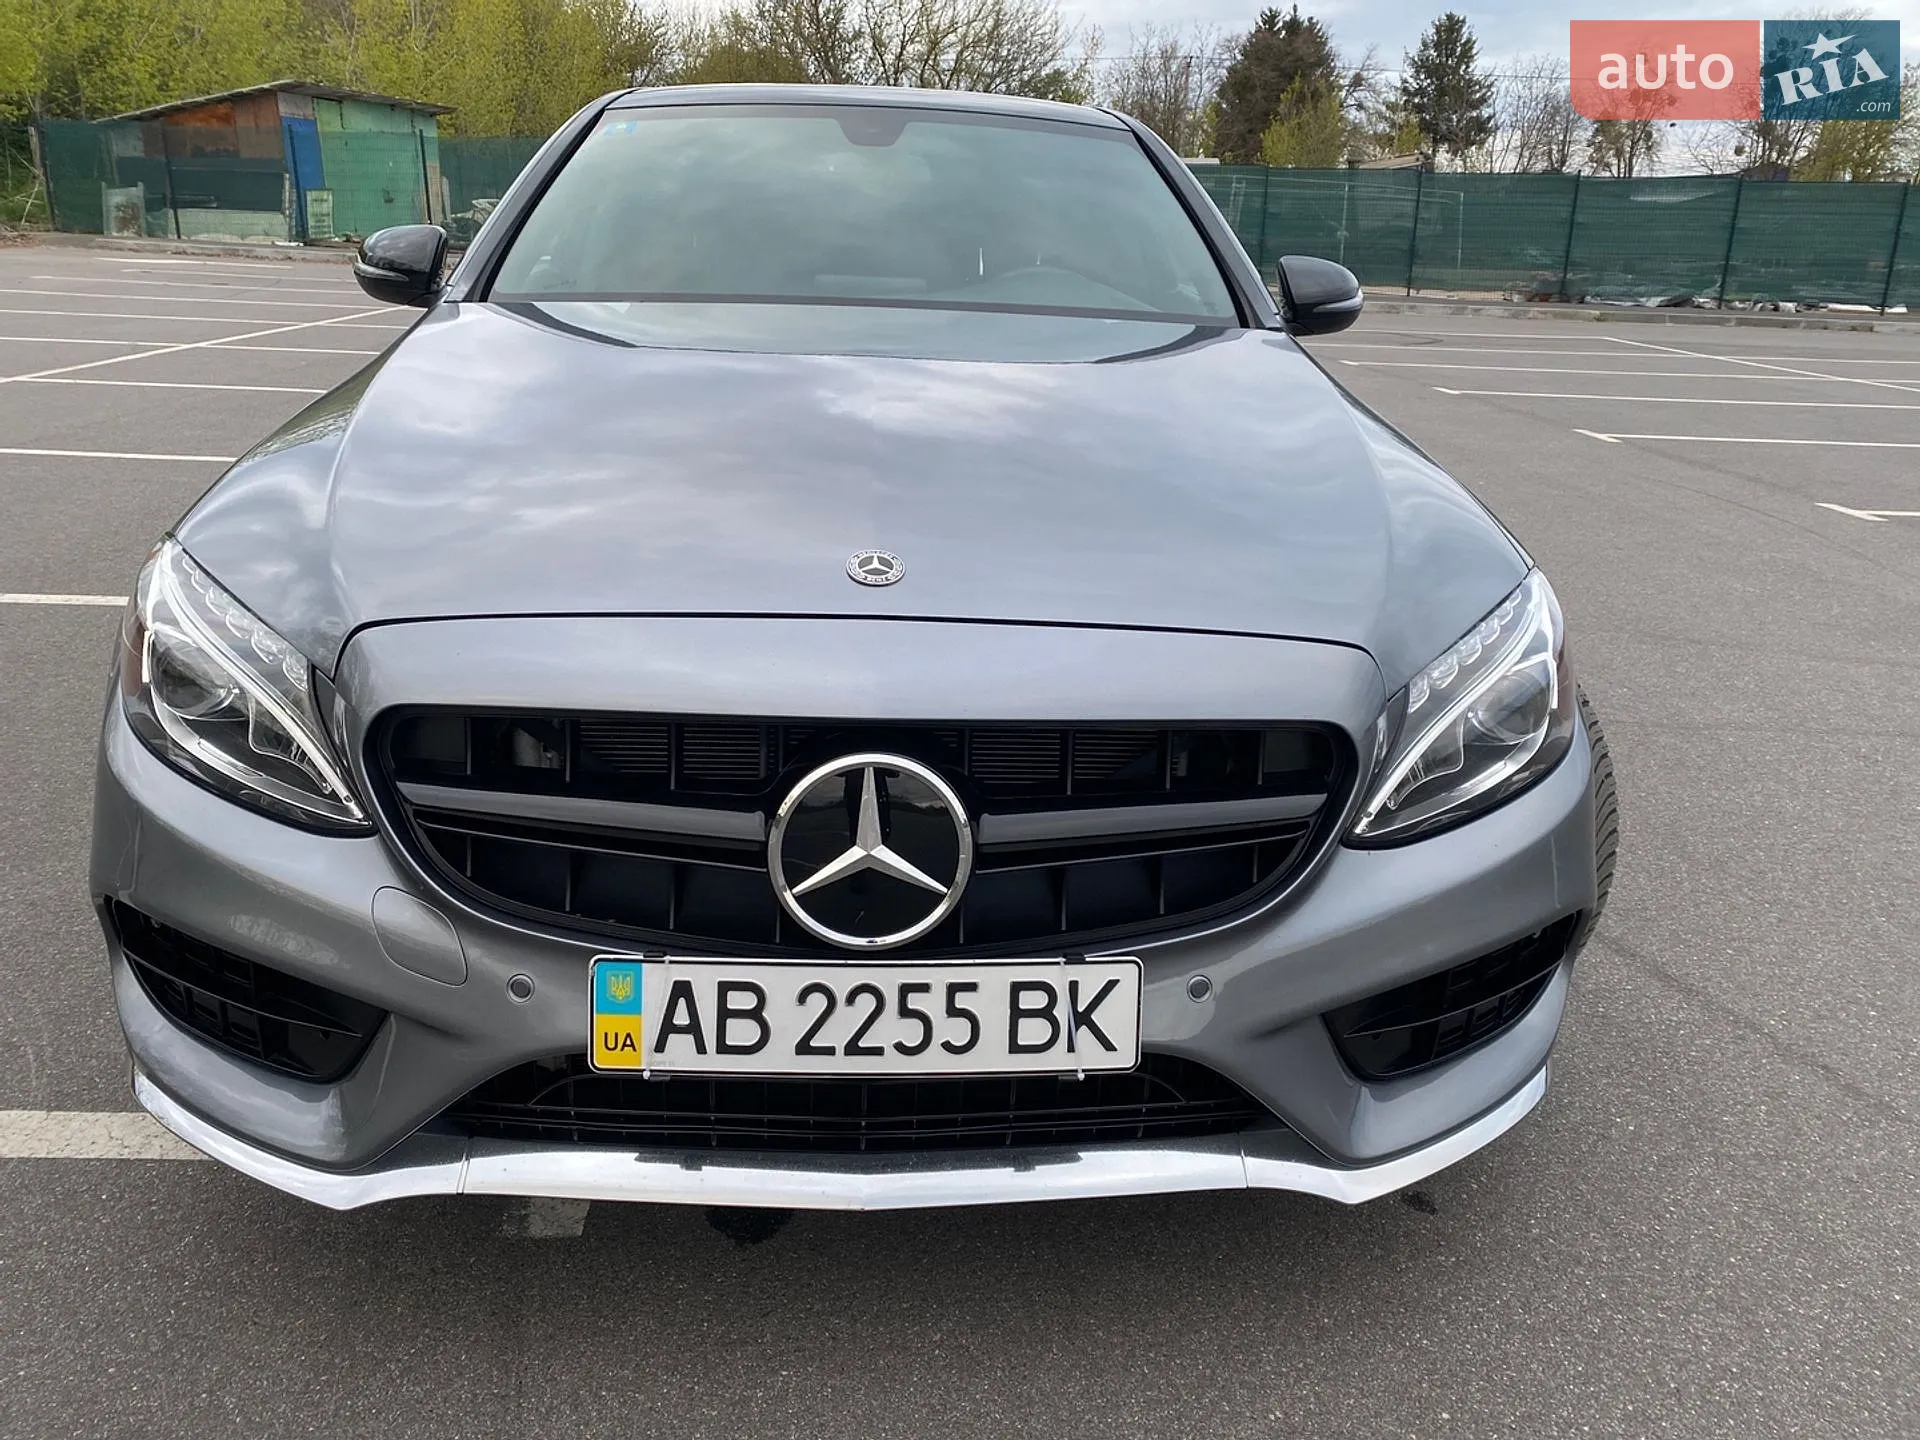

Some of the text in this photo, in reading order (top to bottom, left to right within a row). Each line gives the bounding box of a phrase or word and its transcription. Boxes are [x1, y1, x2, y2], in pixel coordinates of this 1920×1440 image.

[653, 978, 1121, 1056] AB 2255 BK
[603, 1031, 638, 1054] UA
